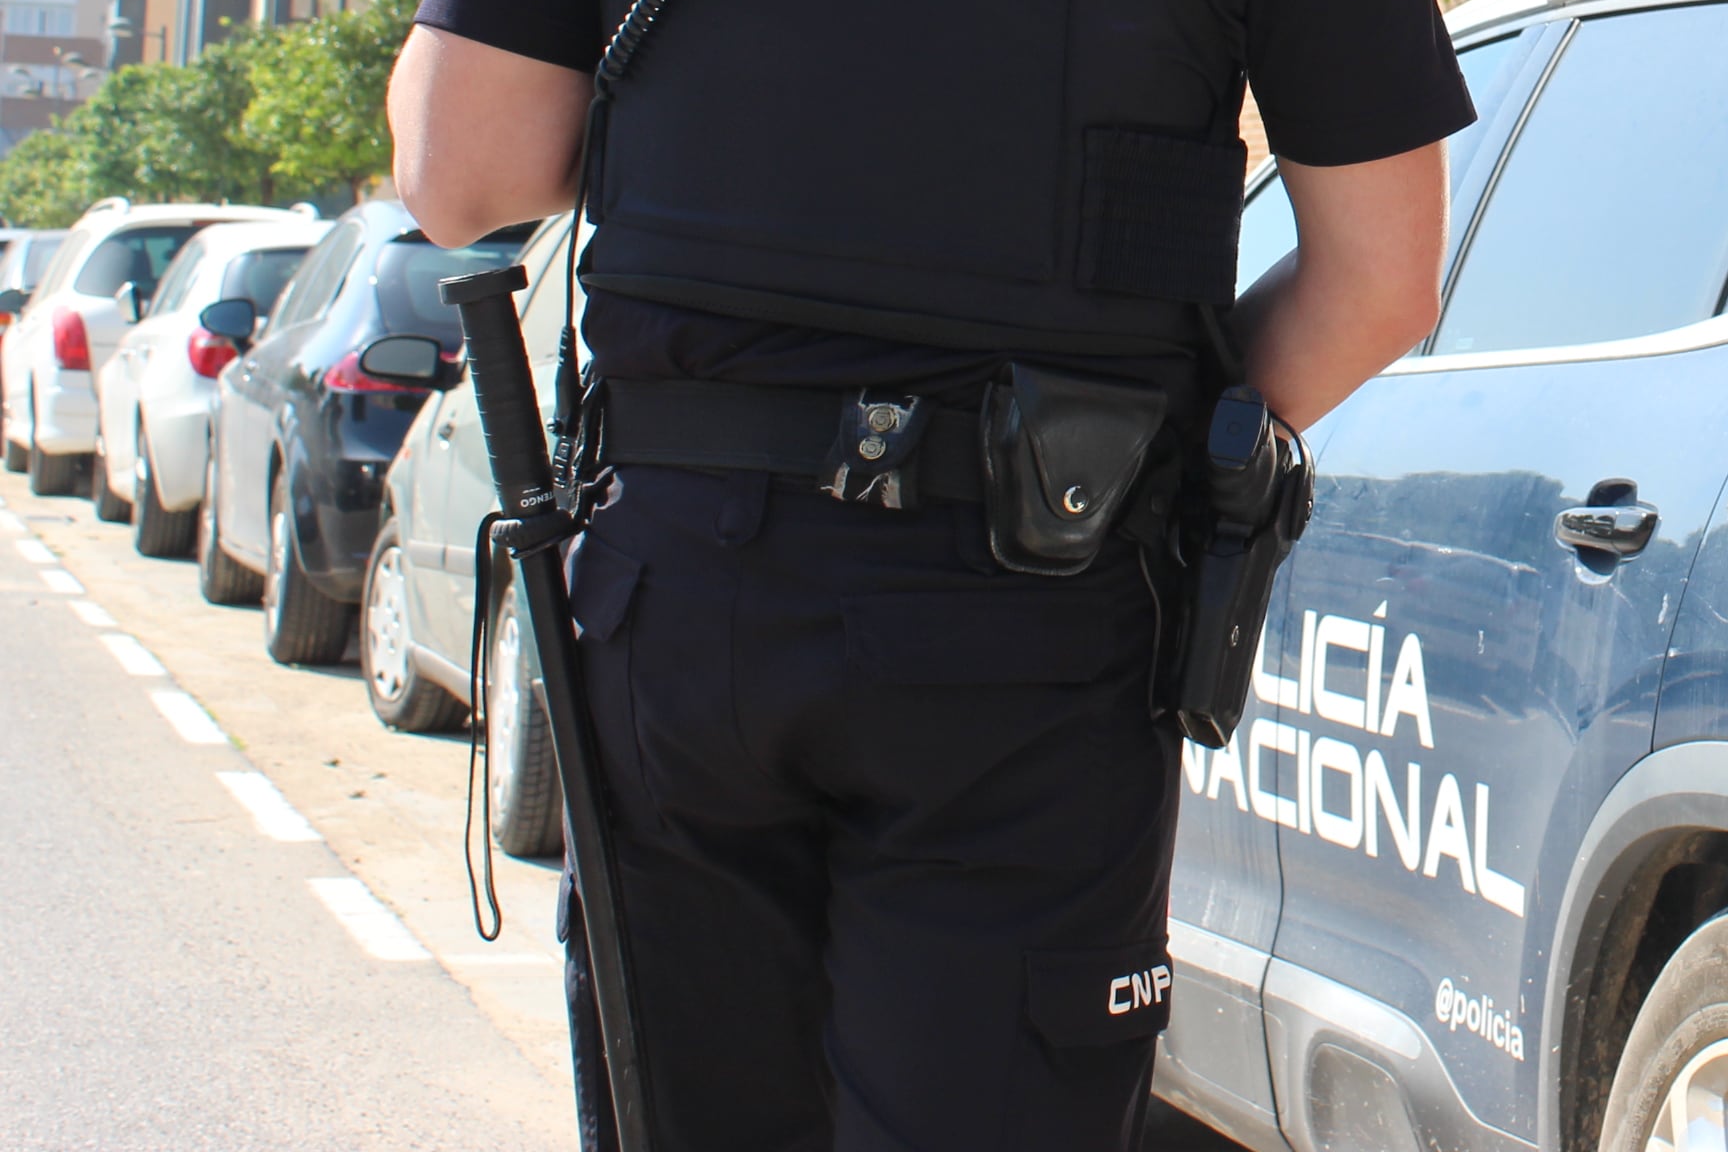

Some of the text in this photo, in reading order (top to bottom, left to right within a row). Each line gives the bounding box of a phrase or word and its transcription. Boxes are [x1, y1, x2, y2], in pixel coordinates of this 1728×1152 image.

[1252, 600, 1434, 749] LICÍA
[1108, 964, 1171, 1015] CNP
[1435, 977, 1525, 1062] @policia
